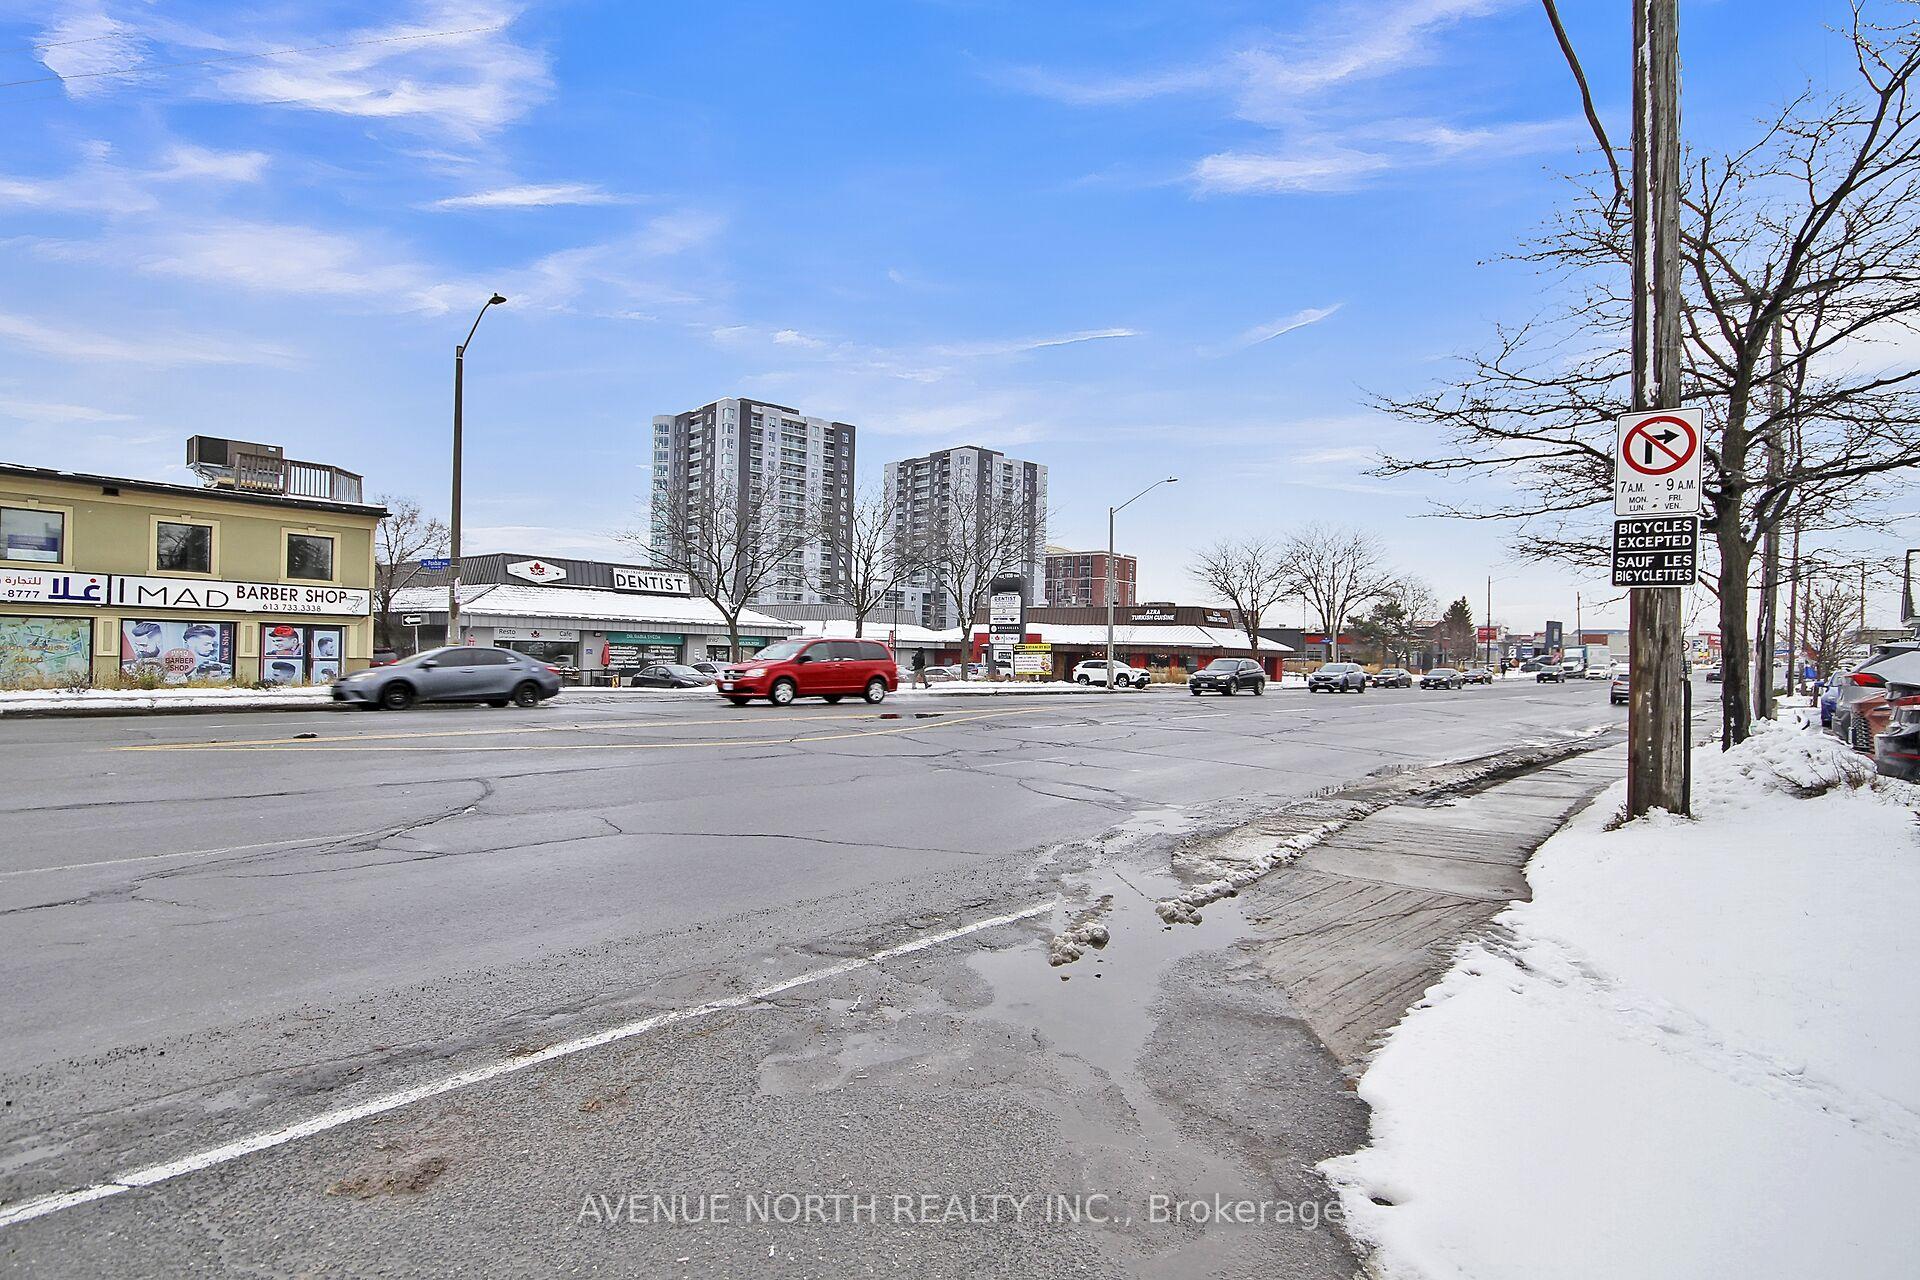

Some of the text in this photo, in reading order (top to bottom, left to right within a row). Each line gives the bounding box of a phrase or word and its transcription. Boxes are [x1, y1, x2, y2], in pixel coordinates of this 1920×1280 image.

[1666, 478, 1674, 491] 9
[1678, 479, 1696, 491] A.M.
[1629, 496, 1648, 504] MON.
[1668, 494, 1683, 502] FRI.
[1629, 502, 1681, 512] LUN. VEN.
[1618, 520, 1692, 535] BICYCLES
[1618, 534, 1692, 549] EXCEPTED
[1616, 555, 1692, 568] SAUF LES
[1615, 568, 1692, 582] BICYCLETTES
[616, 573, 683, 591] DENTIST
[236, 585, 347, 603] BARBER SHOP
[262, 603, 322, 612] 613 733.3338
[169, 664, 190, 672] SHOP
